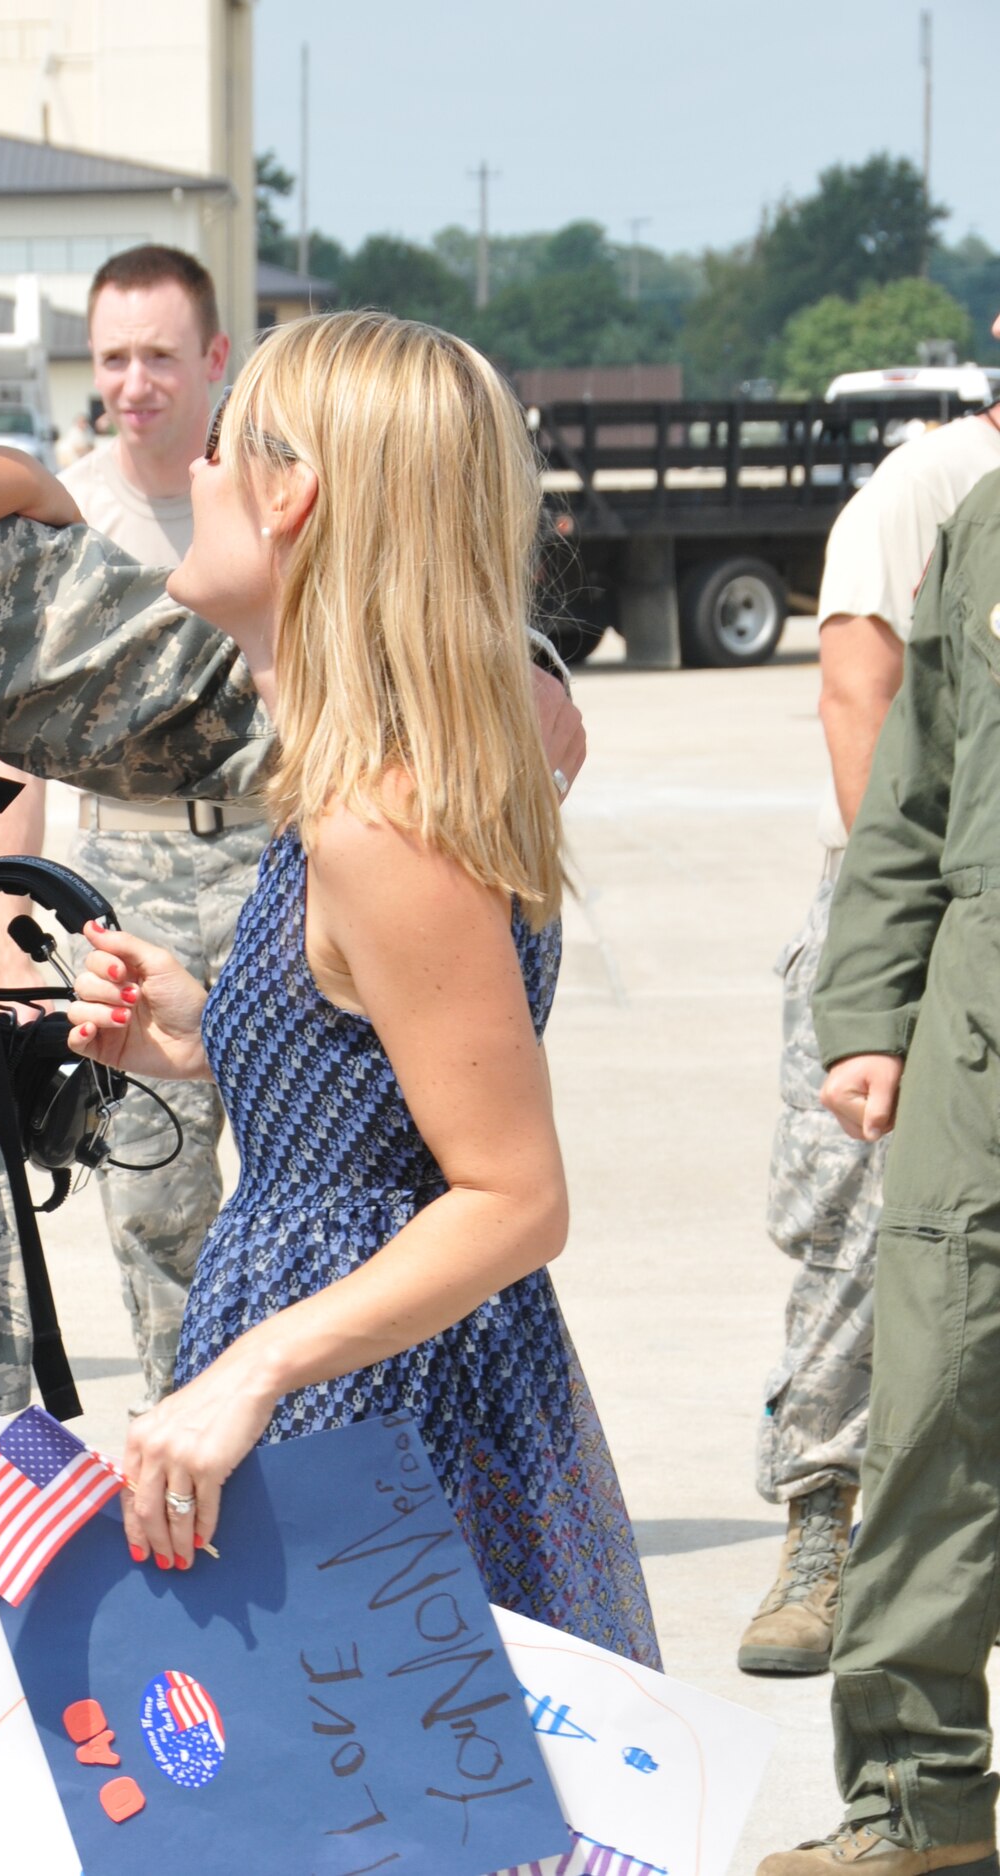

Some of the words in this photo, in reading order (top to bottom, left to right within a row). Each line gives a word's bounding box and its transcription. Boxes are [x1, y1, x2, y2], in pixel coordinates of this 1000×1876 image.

[140, 1696, 154, 1729] Home
[146, 1730, 176, 1776] Welcome
[300, 1641, 388, 1835] LOVE
